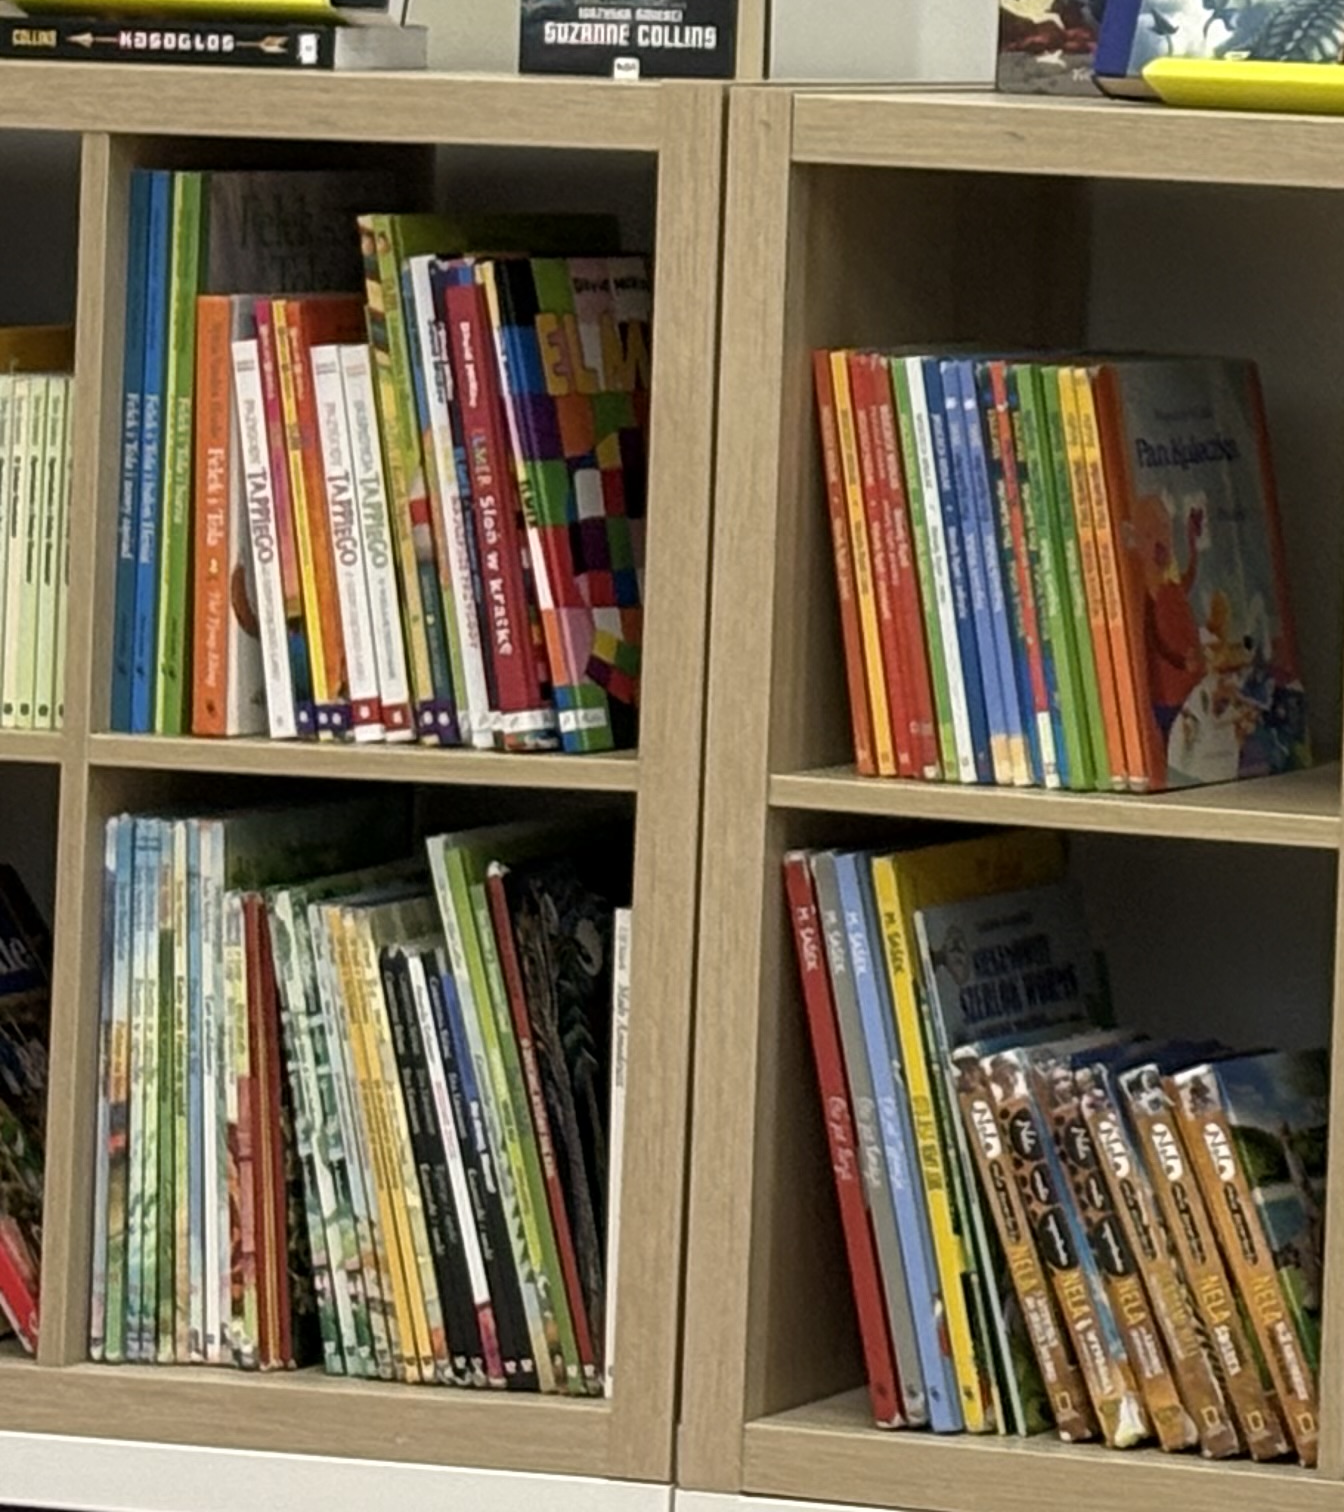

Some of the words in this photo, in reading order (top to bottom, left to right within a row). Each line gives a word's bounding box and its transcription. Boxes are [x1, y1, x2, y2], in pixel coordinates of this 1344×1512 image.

[543, 20, 630, 48] SUZANNE
[637, 25, 717, 50] COLLINS
[536, 310, 651, 397] ELM
[207, 447, 226, 493] Felek
[206, 506, 224, 547] Tola
[248, 467, 275, 564] TAPPIEGO
[329, 471, 358, 567] TAPPIEGO
[360, 472, 389, 569] TAPPIEGO
